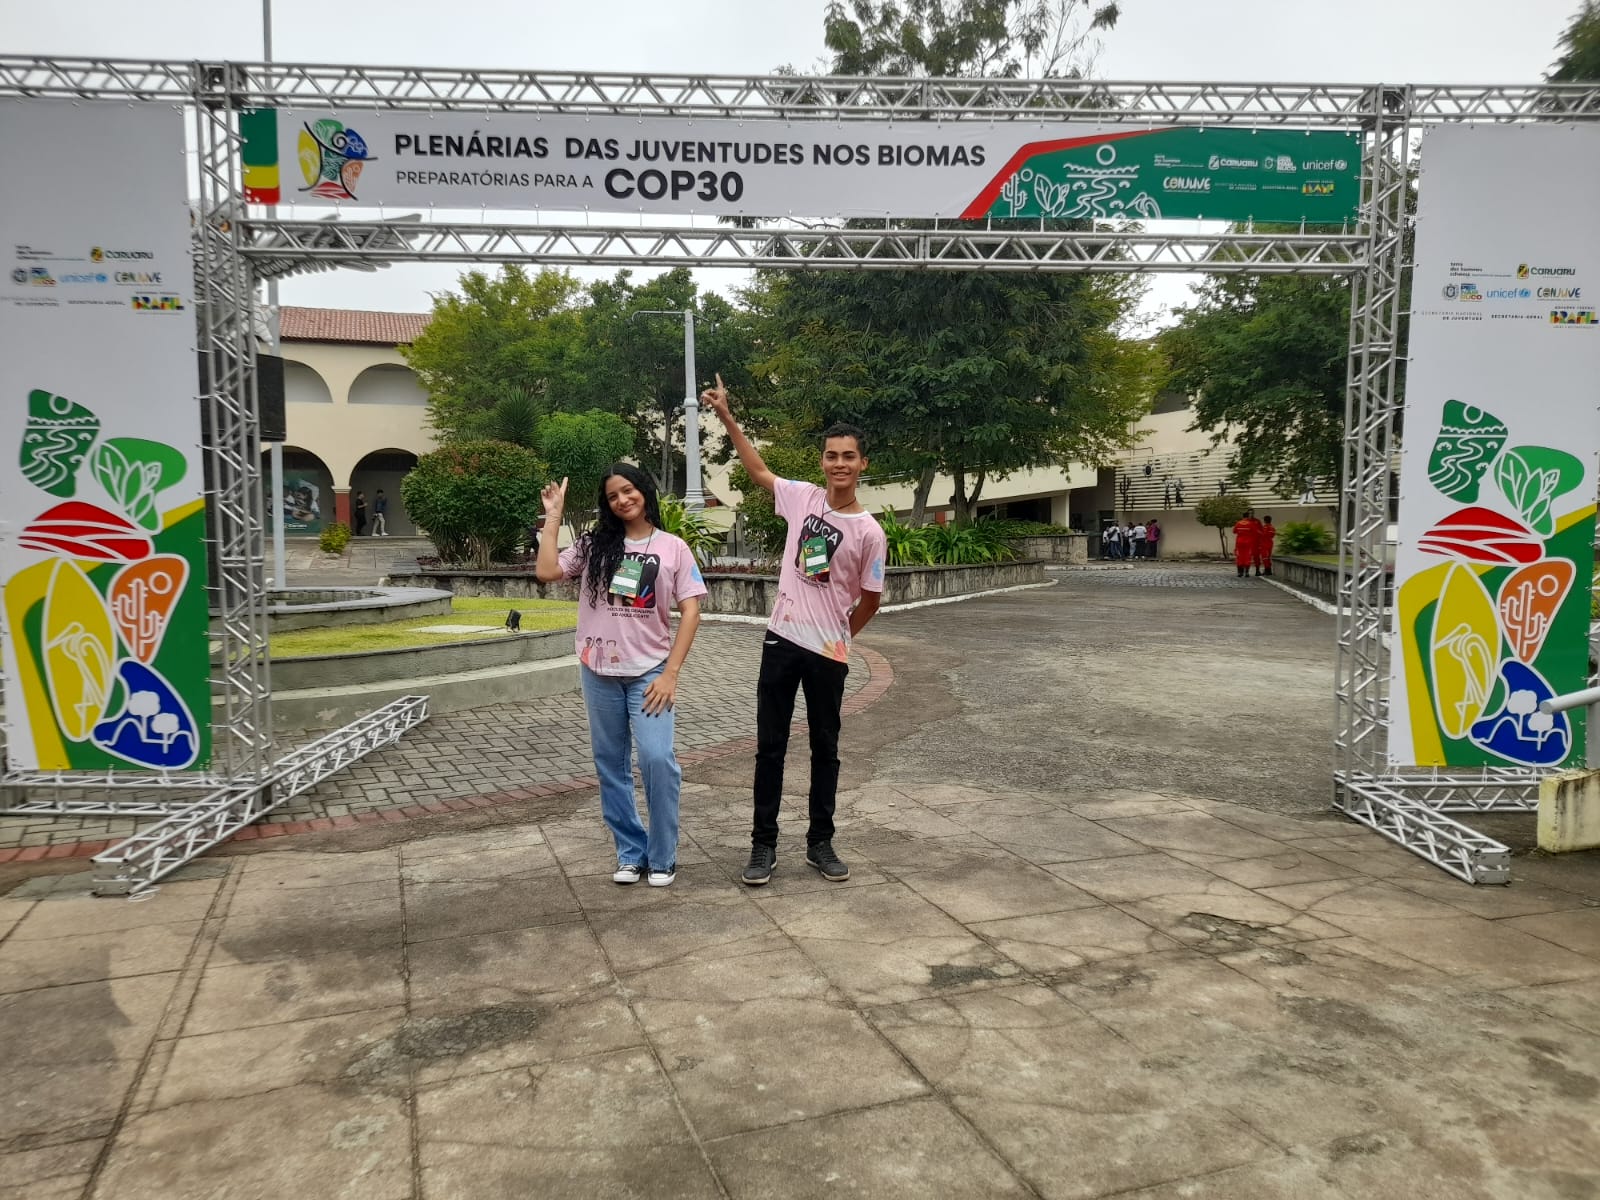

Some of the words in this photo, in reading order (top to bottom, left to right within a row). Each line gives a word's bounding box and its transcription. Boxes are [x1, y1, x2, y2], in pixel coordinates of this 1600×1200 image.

[395, 130, 549, 159] PLENÁRIAS
[565, 137, 620, 161] DAS
[626, 139, 804, 165] JUVENTUDES
[813, 144, 871, 166] NOS
[878, 144, 986, 167] BIOMAS
[1302, 159, 1335, 171] unicef
[396, 170, 530, 187] PREPARATÓRIAS
[534, 173, 578, 188] PARA
[582, 174, 594, 188] A
[604, 168, 743, 202] COP30
[1486, 287, 1519, 299] unicef
[1537, 286, 1582, 298] CONJUVE
[1550, 310, 1599, 324] BRASIL
[804, 516, 838, 546] NUCA
